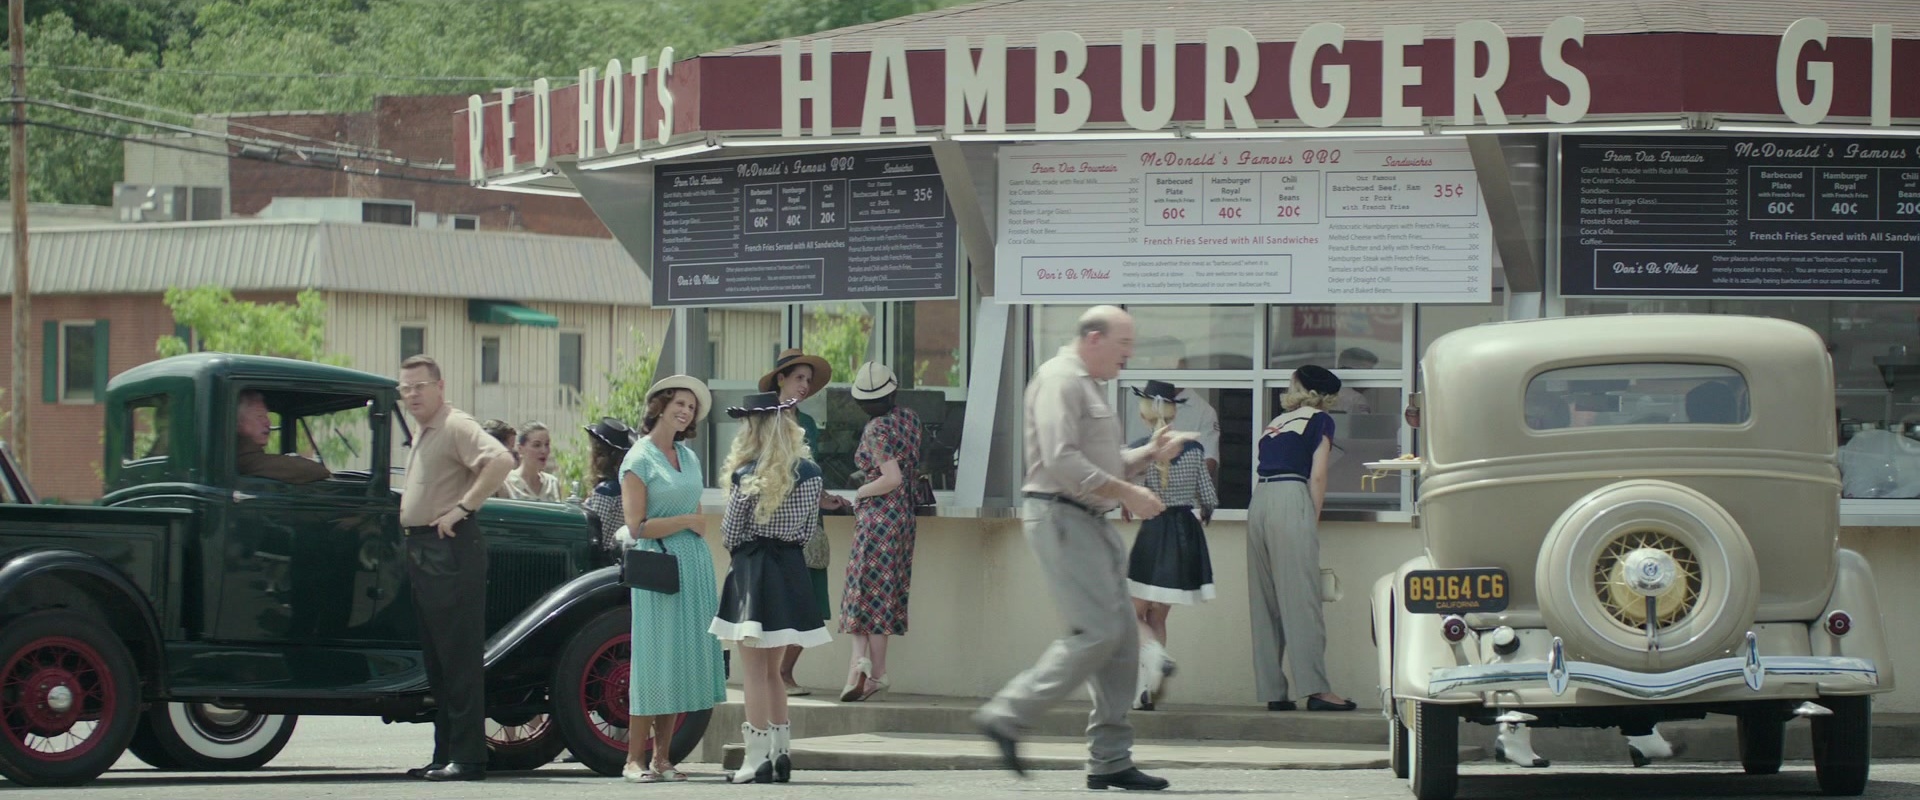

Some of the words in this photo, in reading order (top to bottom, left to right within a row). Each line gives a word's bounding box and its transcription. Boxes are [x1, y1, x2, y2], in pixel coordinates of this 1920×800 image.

[781, 16, 1591, 136] HAMBURGERS
[468, 77, 549, 181] RED
[579, 47, 674, 158] HOTS
[1602, 150, 1632, 162] From
[1636, 151, 1656, 162] Our
[1658, 151, 1704, 162] Fountain
[1734, 142, 1834, 158] McDonald's
[1844, 144, 1906, 159] Famous
[1141, 152, 1228, 166] McDonald's
[1236, 151, 1293, 165] Famous
[1302, 150, 1341, 164] BBQ
[1382, 156, 1432, 166] Sandwiches
[737, 161, 788, 177] McDonald's
[793, 160, 826, 173] Famous
[831, 157, 854, 171] BBQ
[1030, 162, 1055, 173] From
[1059, 162, 1076, 172] Our
[1078, 162, 1117, 172] Fountain
[1211, 177, 1251, 186] Hamburger
[1823, 172, 1868, 180] Hamburger
[1222, 187, 1240, 196] Royal
[1434, 184, 1463, 198] 35¢
[1834, 183, 1856, 191] Royal
[914, 188, 933, 202] 35¢
[1162, 208, 1185, 219] 60¢
[1218, 207, 1242, 219] 40¢
[1277, 206, 1300, 218] 20¢
[1768, 202, 1794, 214] 60¢
[1831, 203, 1858, 215] 40¢
[754, 216, 768, 228] 60¢
[786, 215, 800, 226] 40¢
[820, 212, 835, 224] 20¢
[1144, 237, 1173, 246] French
[1175, 237, 1195, 245] Fries
[1198, 237, 1228, 245] Served
[1230, 236, 1250, 244] with
[1252, 236, 1264, 244] All
[1267, 236, 1318, 244] Sandwiches
[1750, 232, 1782, 240] French
[1785, 232, 1807, 240] Fries
[1810, 232, 1844, 241] Served
[1846, 233, 1867, 241] with
[1870, 233, 1882, 241] All
[745, 244, 761, 252] French
[1037, 268, 1062, 279] Don't
[1081, 268, 1110, 279] Misled
[1613, 262, 1642, 274] Don't
[1646, 262, 1660, 274] Be
[1664, 262, 1698, 274] Misled
[1409, 575, 1472, 600] 89164
[1477, 574, 1504, 598] C6
